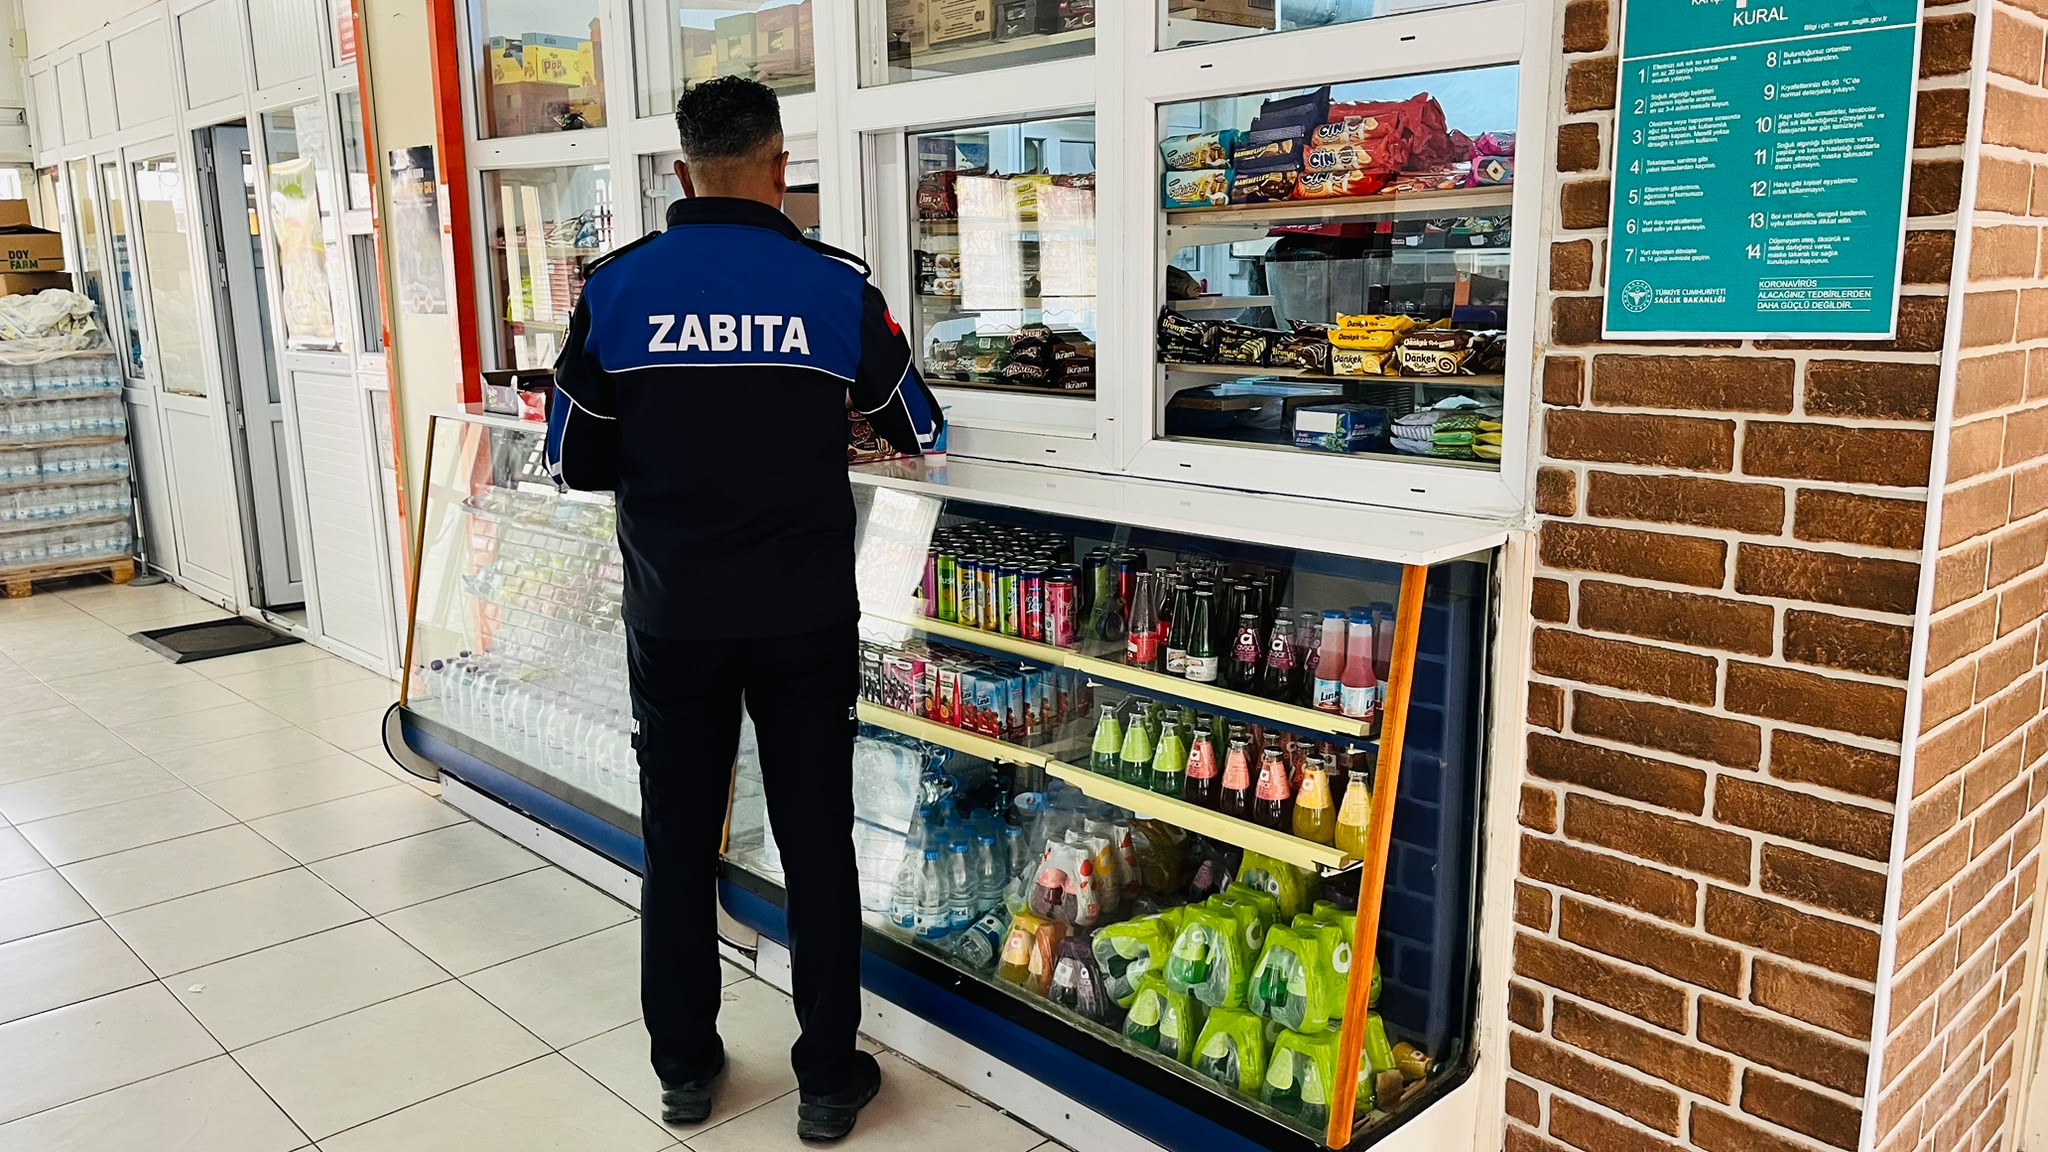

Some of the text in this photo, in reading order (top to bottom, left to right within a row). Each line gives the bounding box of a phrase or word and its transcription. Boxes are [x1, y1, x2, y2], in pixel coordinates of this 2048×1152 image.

[1733, 6, 1788, 27] KURAL
[1766, 52, 1776, 68] 8
[1639, 69, 1645, 83] 1
[1822, 79, 1839, 87] 60-90
[1764, 84, 1774, 100] 9
[1634, 99, 1644, 114] 2
[1755, 117, 1771, 133] 10
[1632, 129, 1641, 144] 3
[1754, 149, 1766, 165] 11
[1630, 160, 1639, 174] 4
[1750, 181, 1766, 196] 12
[1628, 190, 1638, 204] 5
[1627, 219, 1635, 233] 6
[1748, 213, 1764, 228] 13
[8, 250, 29, 259] DOY
[1625, 248, 1634, 263] 7
[1746, 244, 1760, 259] 14
[10, 260, 38, 269] FARM
[1759, 279, 1817, 288] KORONAVİRÜS
[1758, 289, 1871, 298] ALACAĞINIZ TEDBİRLERDEN
[1781, 301, 1810, 311] GÜÇLÜ
[648, 314, 810, 355] ZABITA
[1334, 354, 1362, 364] Dankek
[1405, 352, 1436, 364] Dankek
